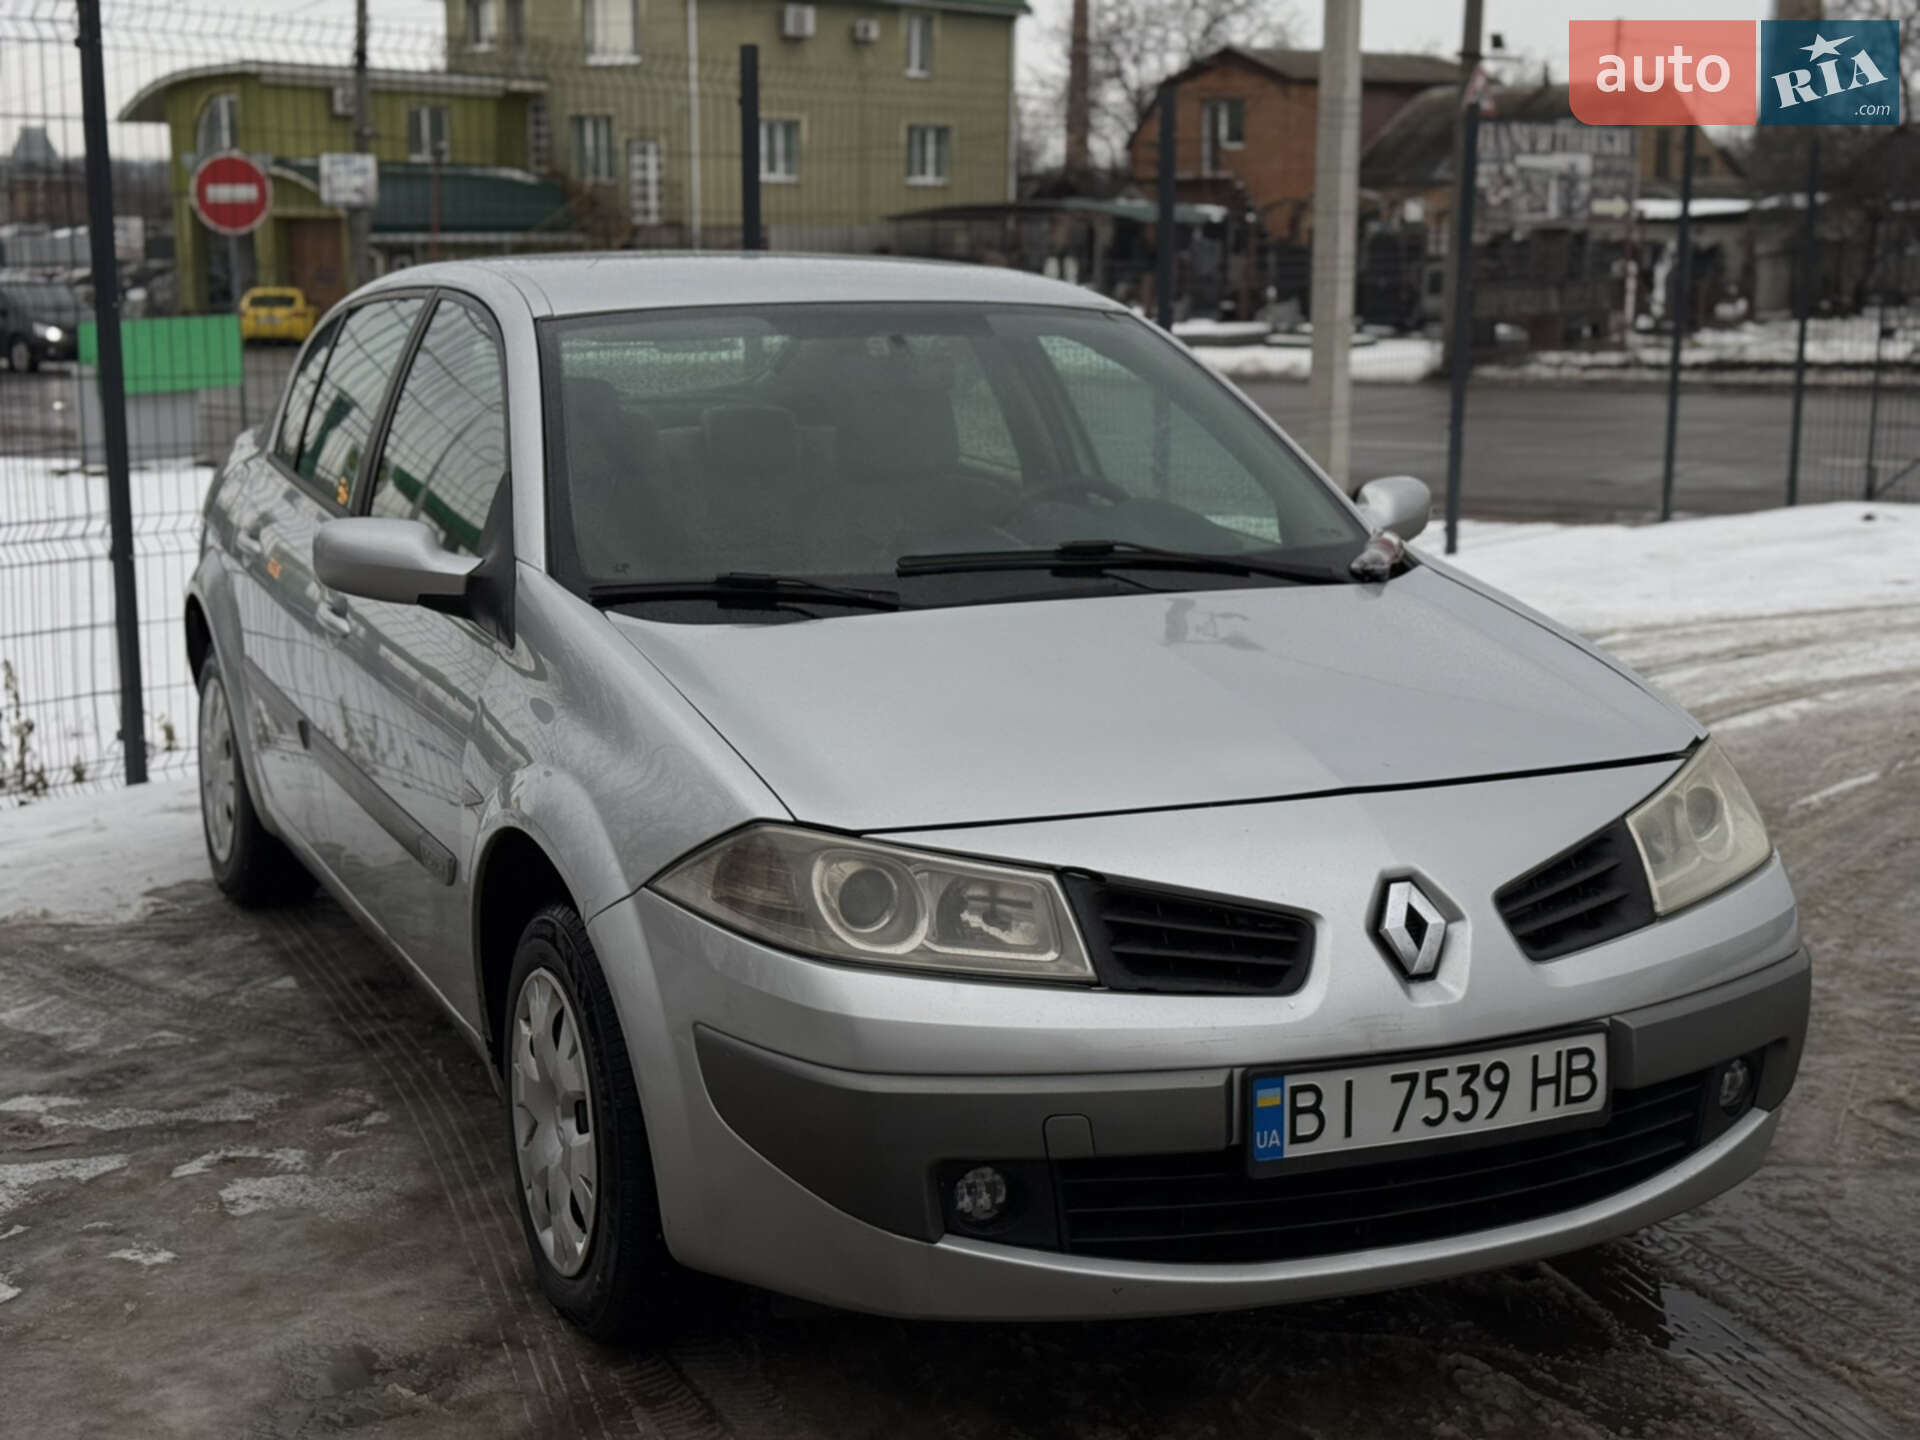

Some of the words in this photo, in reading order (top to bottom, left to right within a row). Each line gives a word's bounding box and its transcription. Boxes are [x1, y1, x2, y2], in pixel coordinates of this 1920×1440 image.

[1289, 1080, 1353, 1145] BI
[1390, 1060, 1511, 1133] 7539
[1530, 1046, 1598, 1112] HB
[1256, 1129, 1281, 1149] UA
